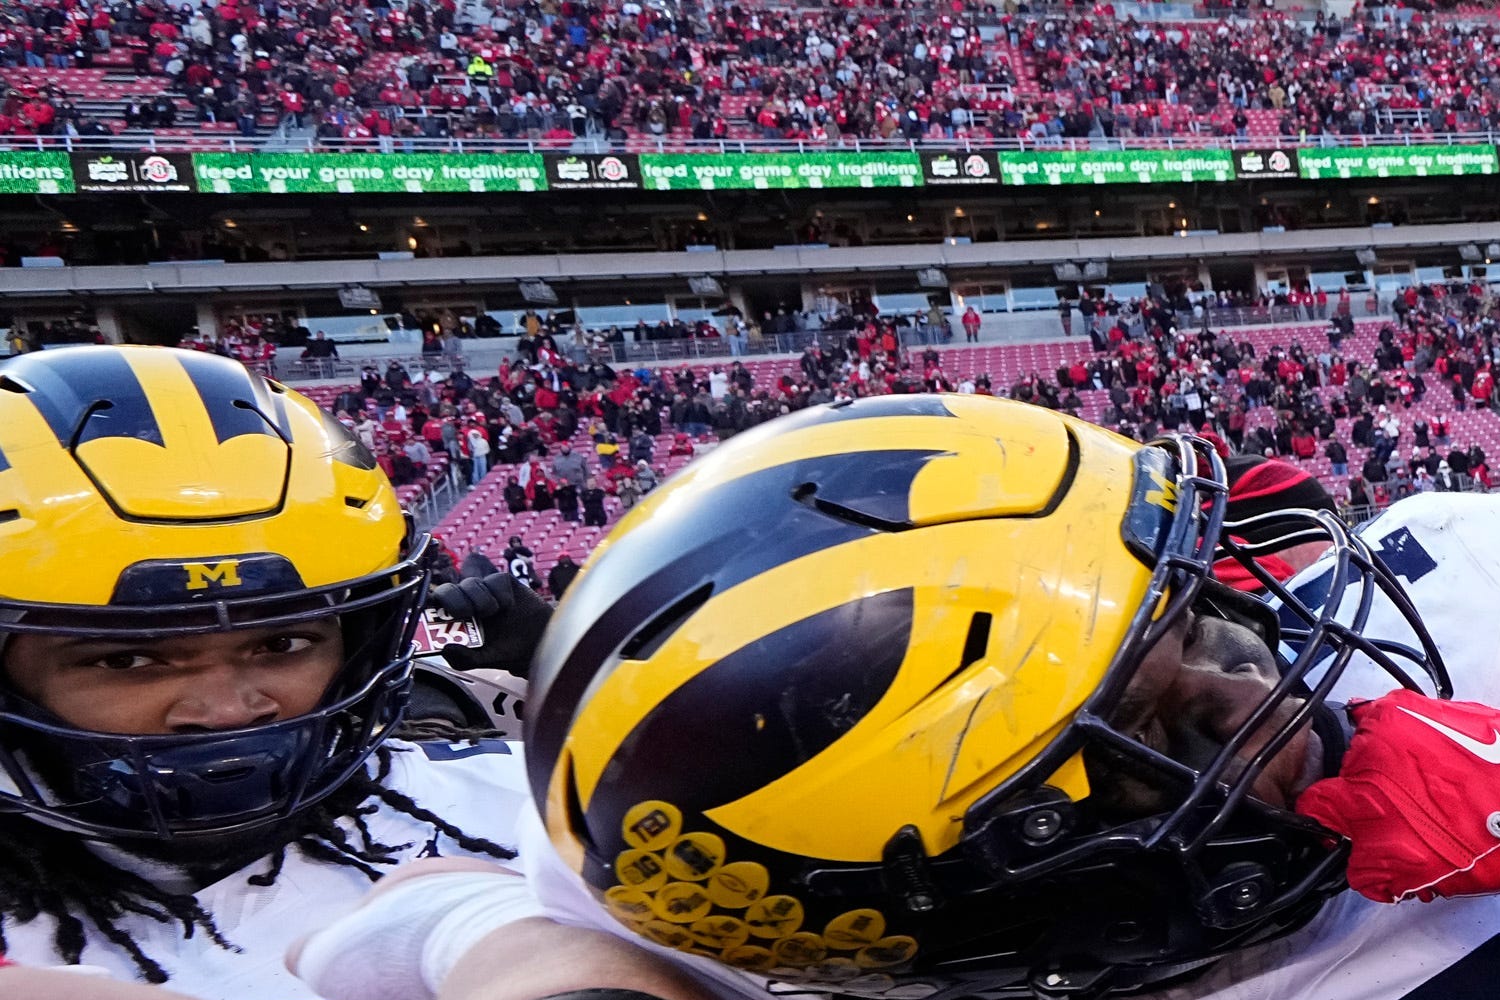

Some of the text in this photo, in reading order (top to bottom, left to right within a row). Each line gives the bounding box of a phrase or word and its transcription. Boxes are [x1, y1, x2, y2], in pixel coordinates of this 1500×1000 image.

[644, 163, 688, 178] feed
[693, 165, 734, 180] your
[740, 165, 792, 180] game
[800, 164, 832, 180] day
[838, 163, 918, 177] traditions
[1003, 161, 1038, 174] feed
[1042, 163, 1076, 176] your
[1081, 163, 1125, 176] game
[1130, 161, 1158, 175] day
[1162, 158, 1229, 171] traditions
[1334, 157, 1363, 170] your
[199, 164, 540, 183] feed your game day traditions
[183, 558, 243, 591] M
[428, 620, 470, 650] 36
